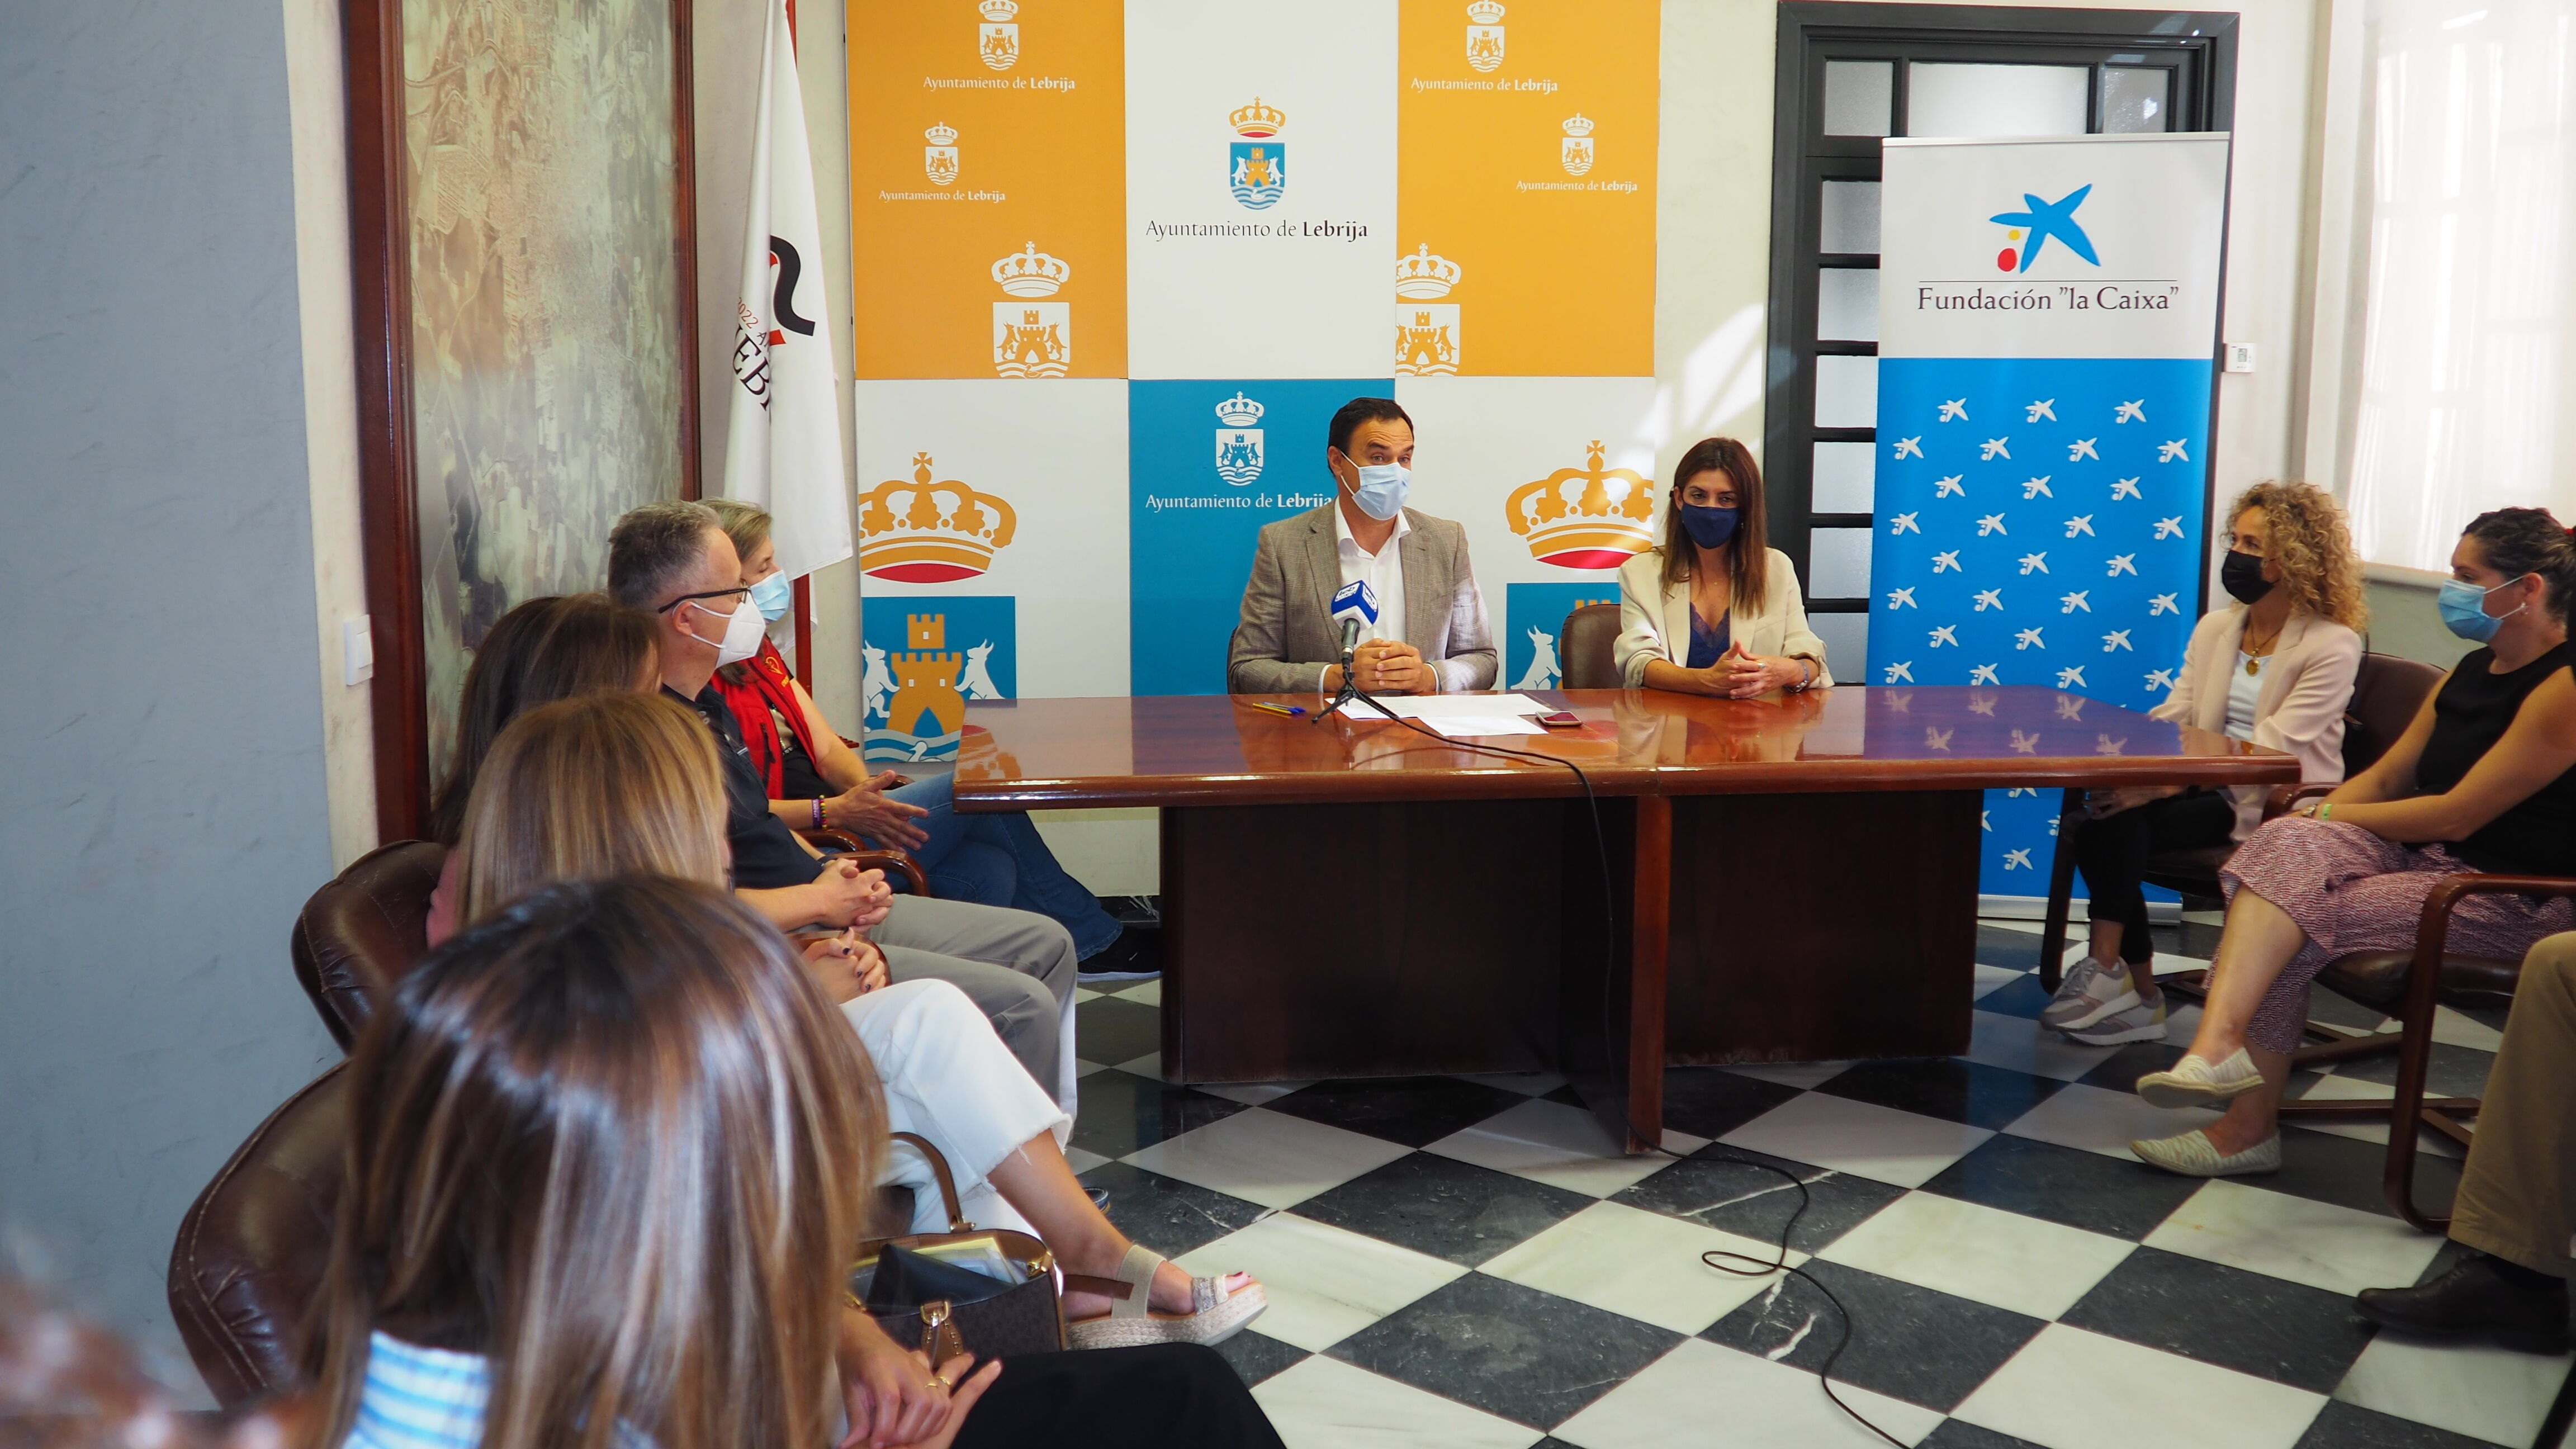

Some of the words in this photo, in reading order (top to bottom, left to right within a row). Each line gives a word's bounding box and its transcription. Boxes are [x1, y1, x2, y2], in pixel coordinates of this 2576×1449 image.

[923, 76, 1009, 92] Ayuntamiento
[1012, 75, 1027, 89] de
[1030, 76, 1076, 93] Lebrija
[1411, 77, 1494, 93] Ayuntamiento
[1497, 78, 1511, 91] de
[1514, 78, 1559, 95] Lebrija
[1516, 180, 1585, 193] Ayuntamiento
[1587, 180, 1599, 191] de
[1601, 181, 1638, 193] Lebrija
[879, 190, 950, 203] Ayuntamiento
[953, 190, 965, 201] de
[968, 190, 1006, 204] Lebrija
[1145, 220, 1271, 242] Ayuntamiento
[1277, 219, 1297, 237] de
[1303, 220, 1368, 243] Lebrija
[1917, 286, 2052, 310] Fundación
[1145, 494, 1251, 513] Ayuntamiento
[1255, 493, 1273, 508] de
